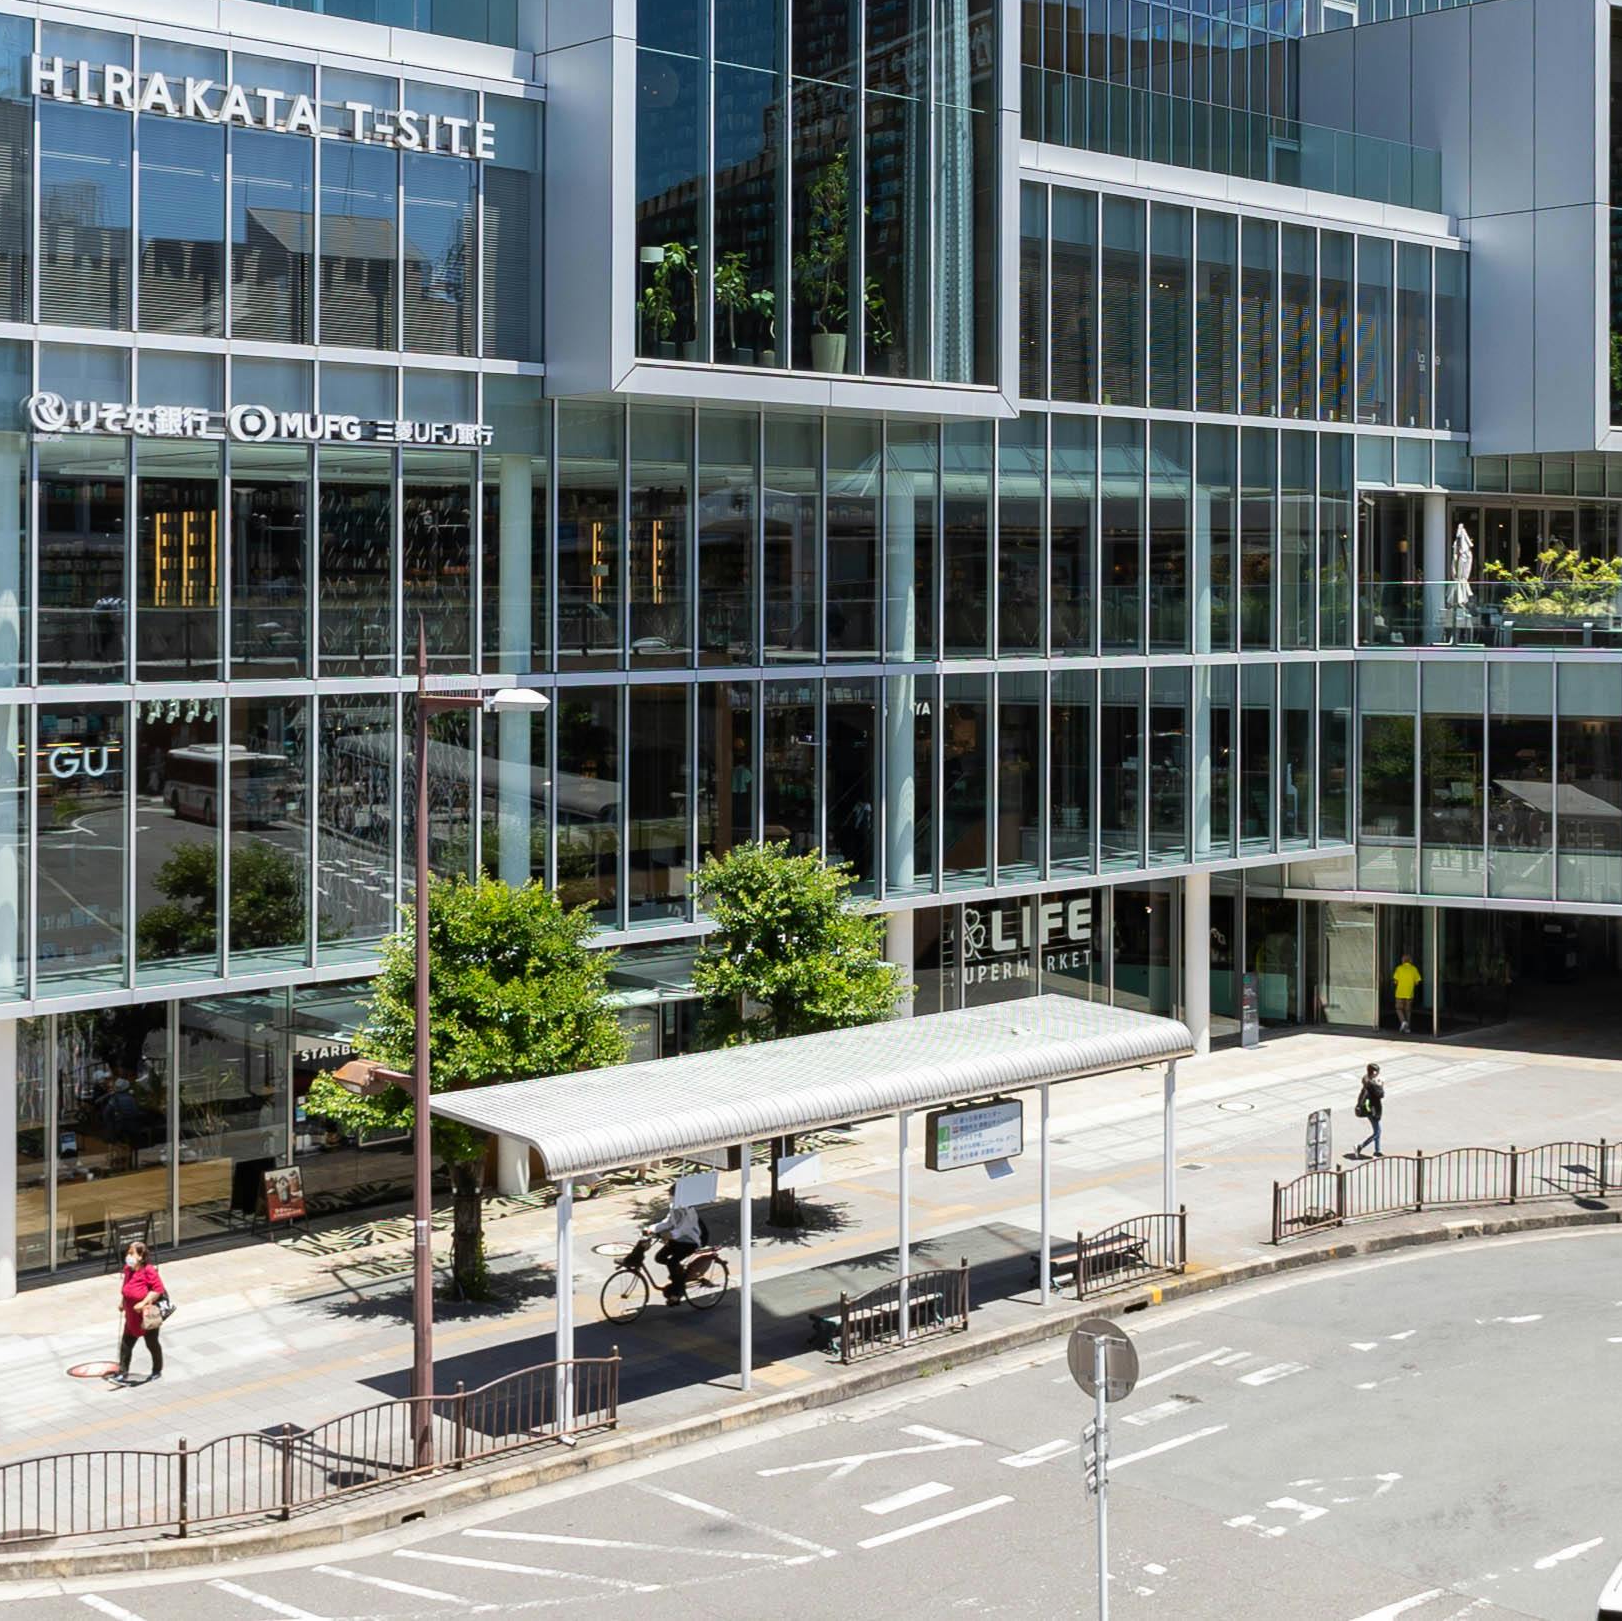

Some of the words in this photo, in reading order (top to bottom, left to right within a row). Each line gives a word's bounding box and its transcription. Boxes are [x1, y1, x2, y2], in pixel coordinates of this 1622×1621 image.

[31, 52, 320, 134] HIRAKATA
[343, 100, 496, 160] T-SITE
[74, 400, 210, 437] りそな銀行
[281, 411, 362, 441] MUFG
[375, 420, 494, 446] 三菱UFJ銀行
[49, 745, 108, 778] GU
[991, 898, 1092, 952] LIFE
[951, 949, 1092, 987] UPERMRKET
